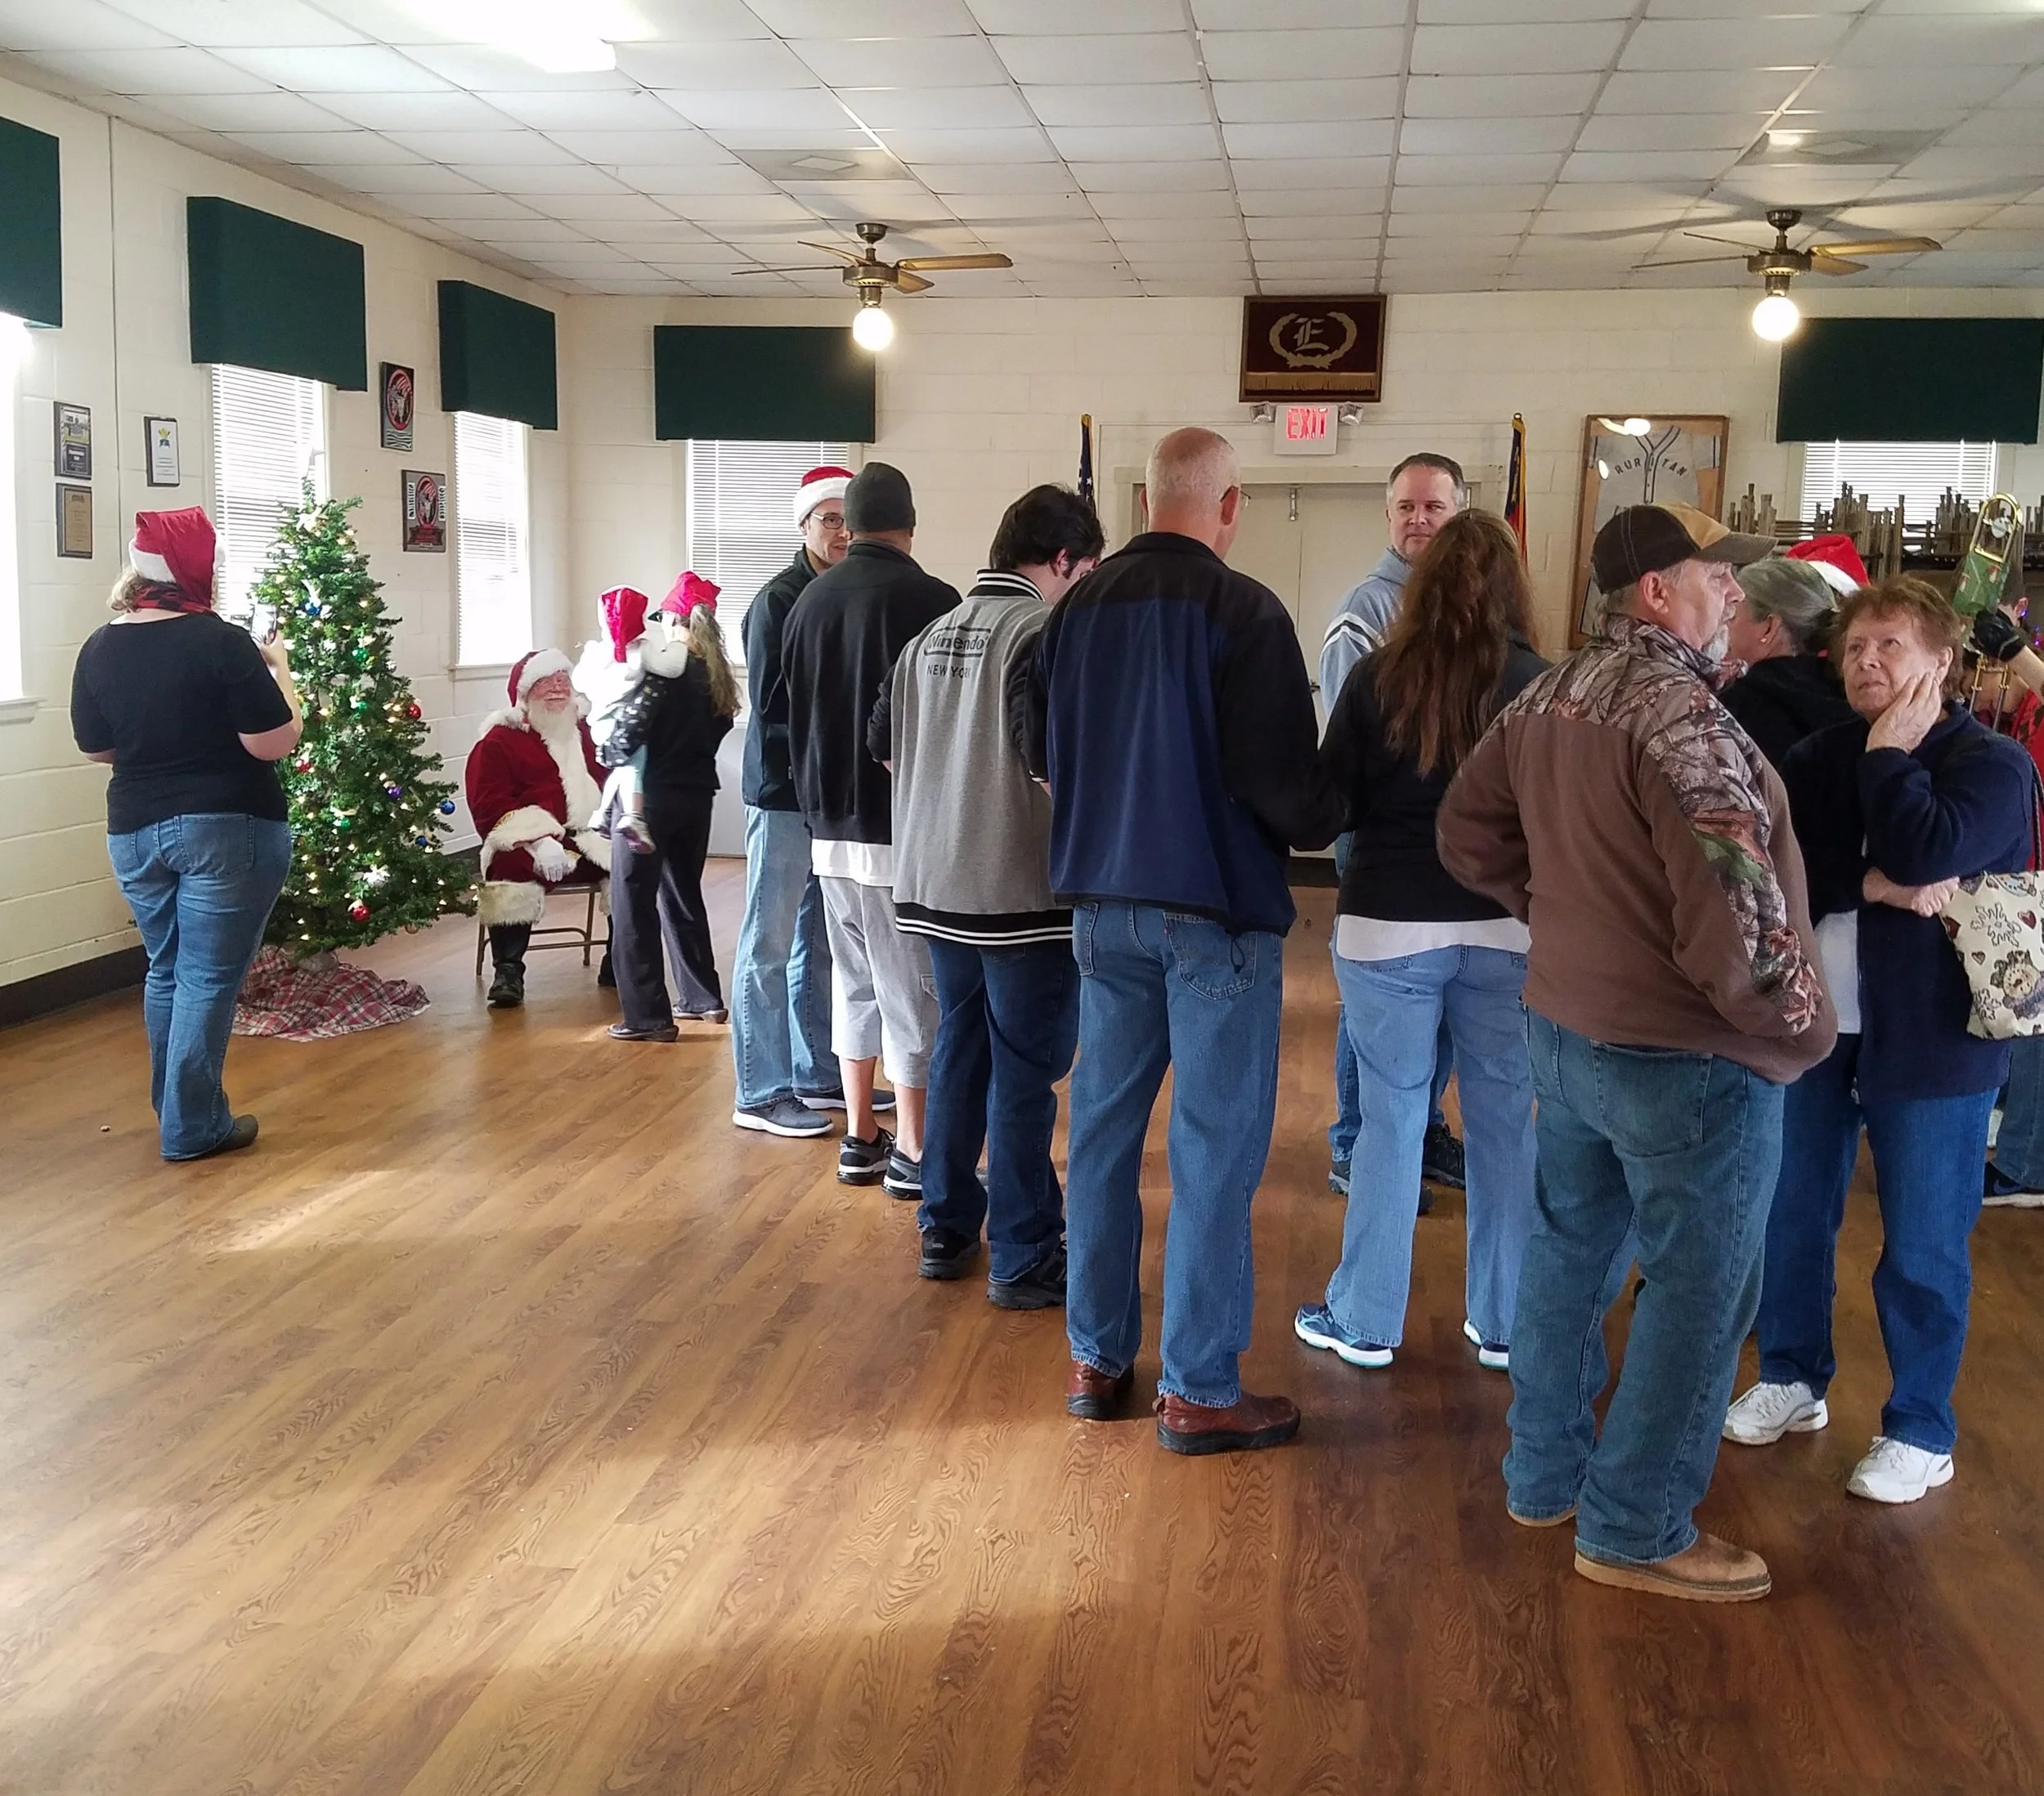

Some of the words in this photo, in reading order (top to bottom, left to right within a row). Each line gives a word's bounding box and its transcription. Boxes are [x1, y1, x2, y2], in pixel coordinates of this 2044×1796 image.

[1293, 317, 1330, 352] E
[1287, 408, 1328, 440] EXIT
[929, 634, 984, 650] Ninendo
[926, 664, 948, 677] NEW
